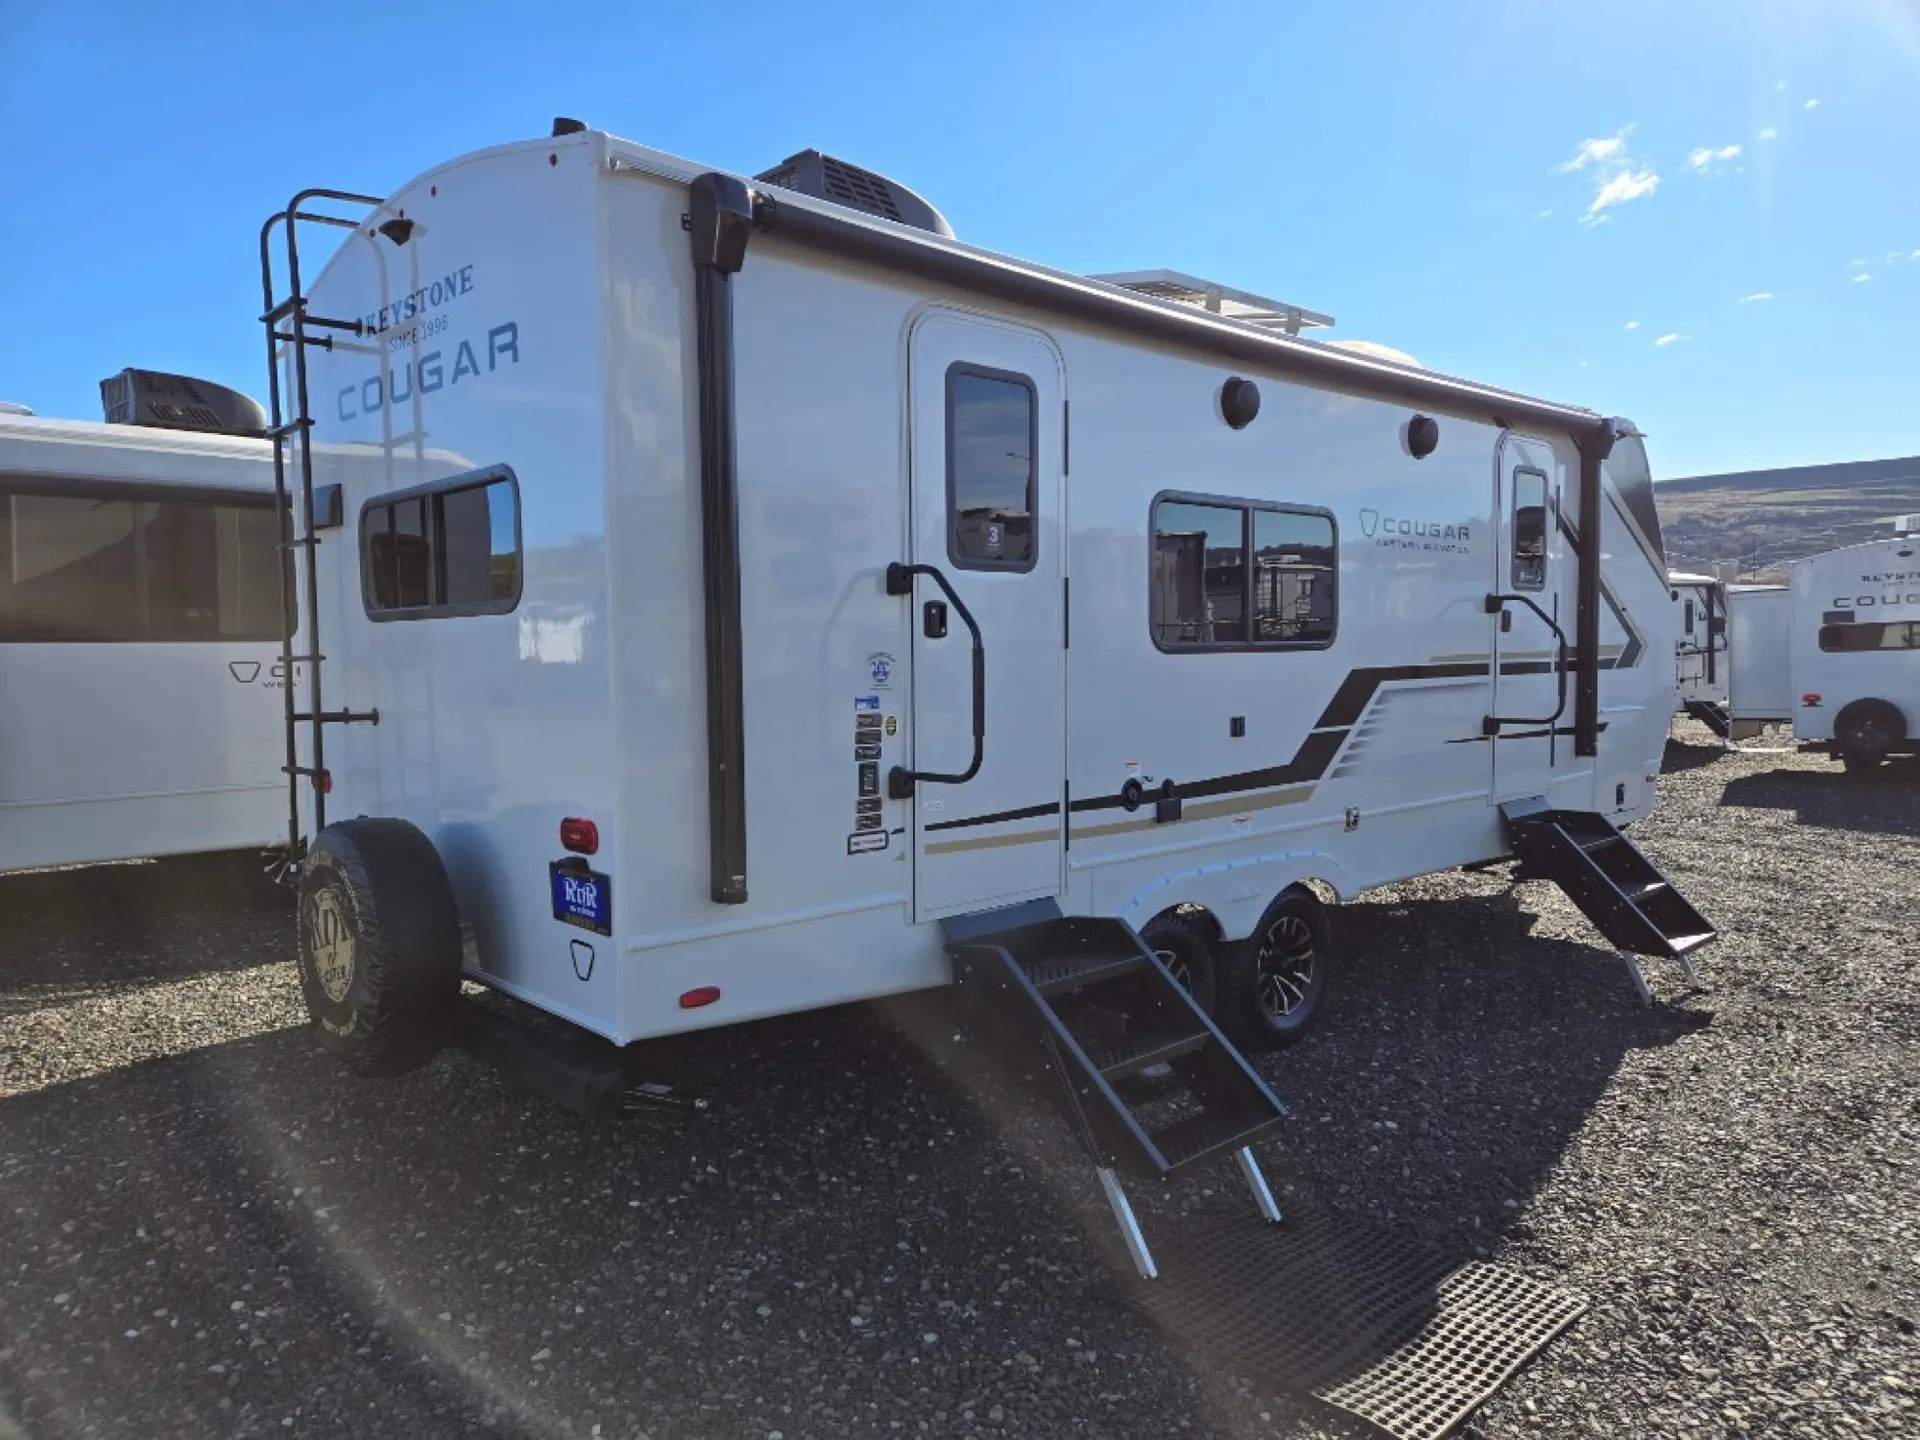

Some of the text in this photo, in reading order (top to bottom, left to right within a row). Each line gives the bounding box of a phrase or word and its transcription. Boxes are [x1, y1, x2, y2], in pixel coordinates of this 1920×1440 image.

[365, 263, 474, 338] KEYSTONE
[337, 321, 519, 422] COUGAR
[1383, 518, 1470, 541] COUGAR
